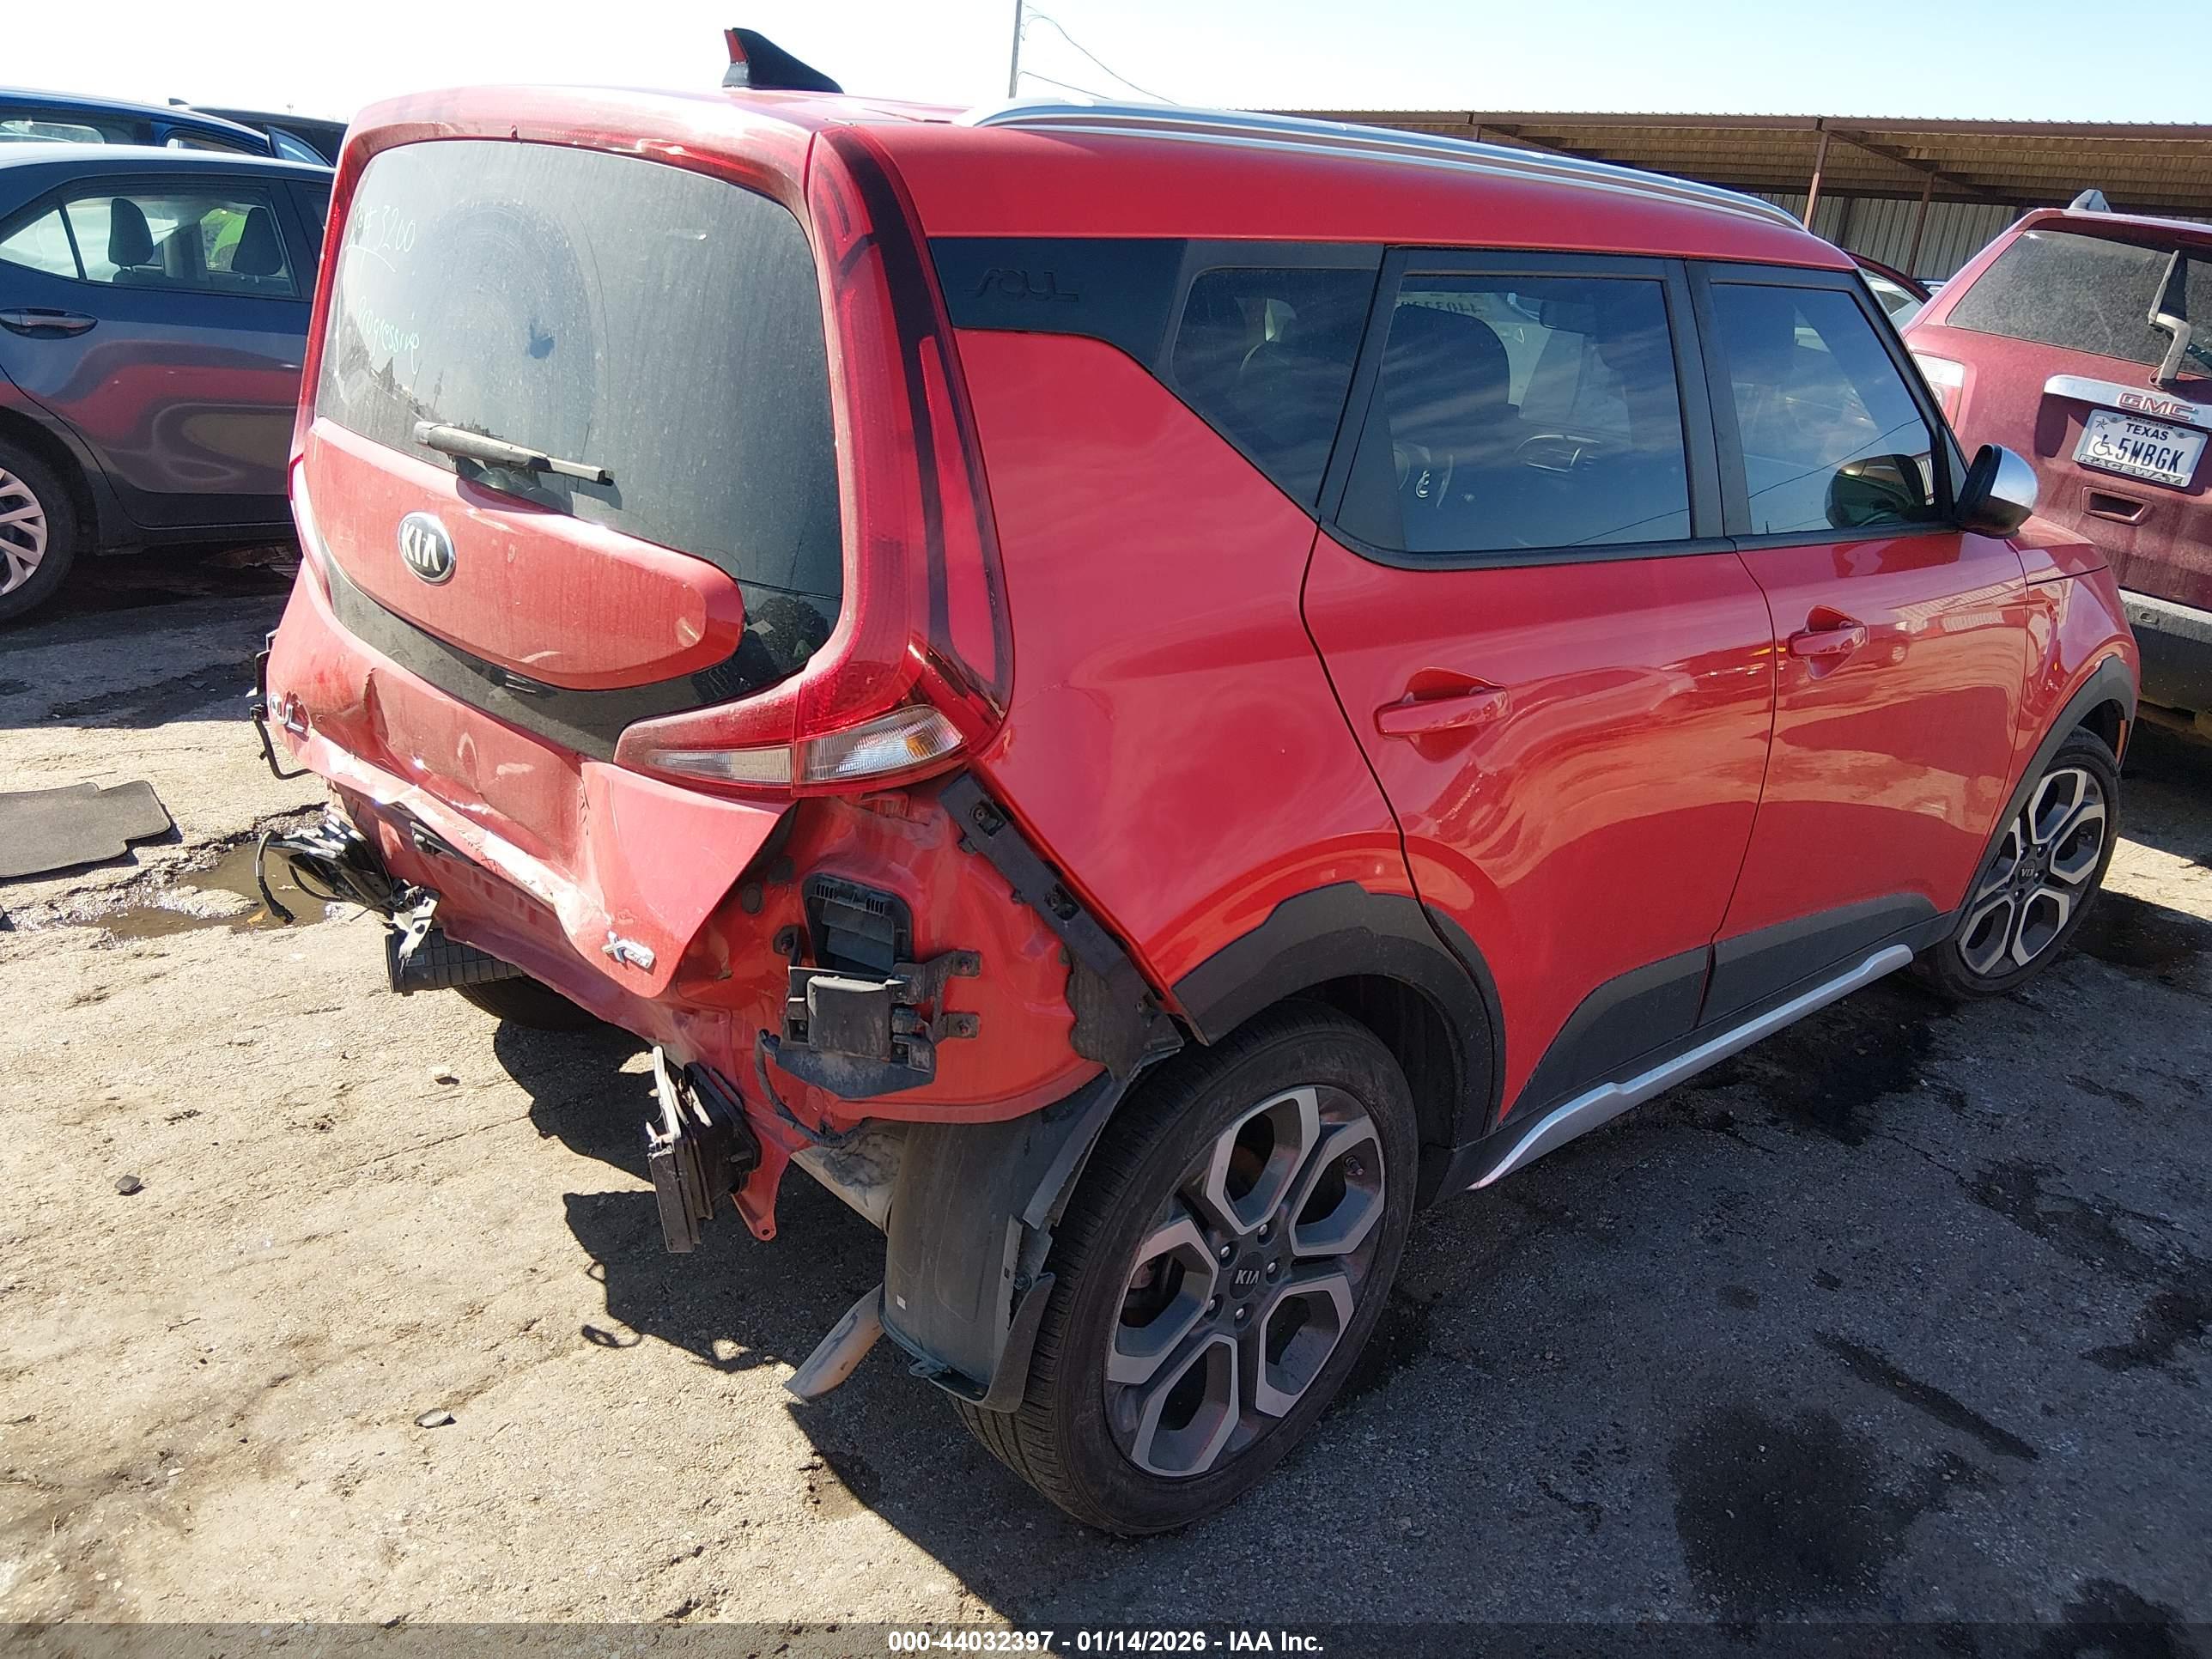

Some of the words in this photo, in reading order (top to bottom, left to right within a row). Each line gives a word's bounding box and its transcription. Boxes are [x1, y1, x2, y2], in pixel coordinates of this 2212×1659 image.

[377, 204, 416, 252] 3200
[2117, 392, 2197, 422] GMC
[2125, 422, 2169, 441] TEXAS
[2079, 454, 2187, 484] RACEWAY
[2115, 437, 2185, 473] 5WBGK
[401, 521, 441, 572] KIA
[1235, 1270, 1260, 1285] KIA
